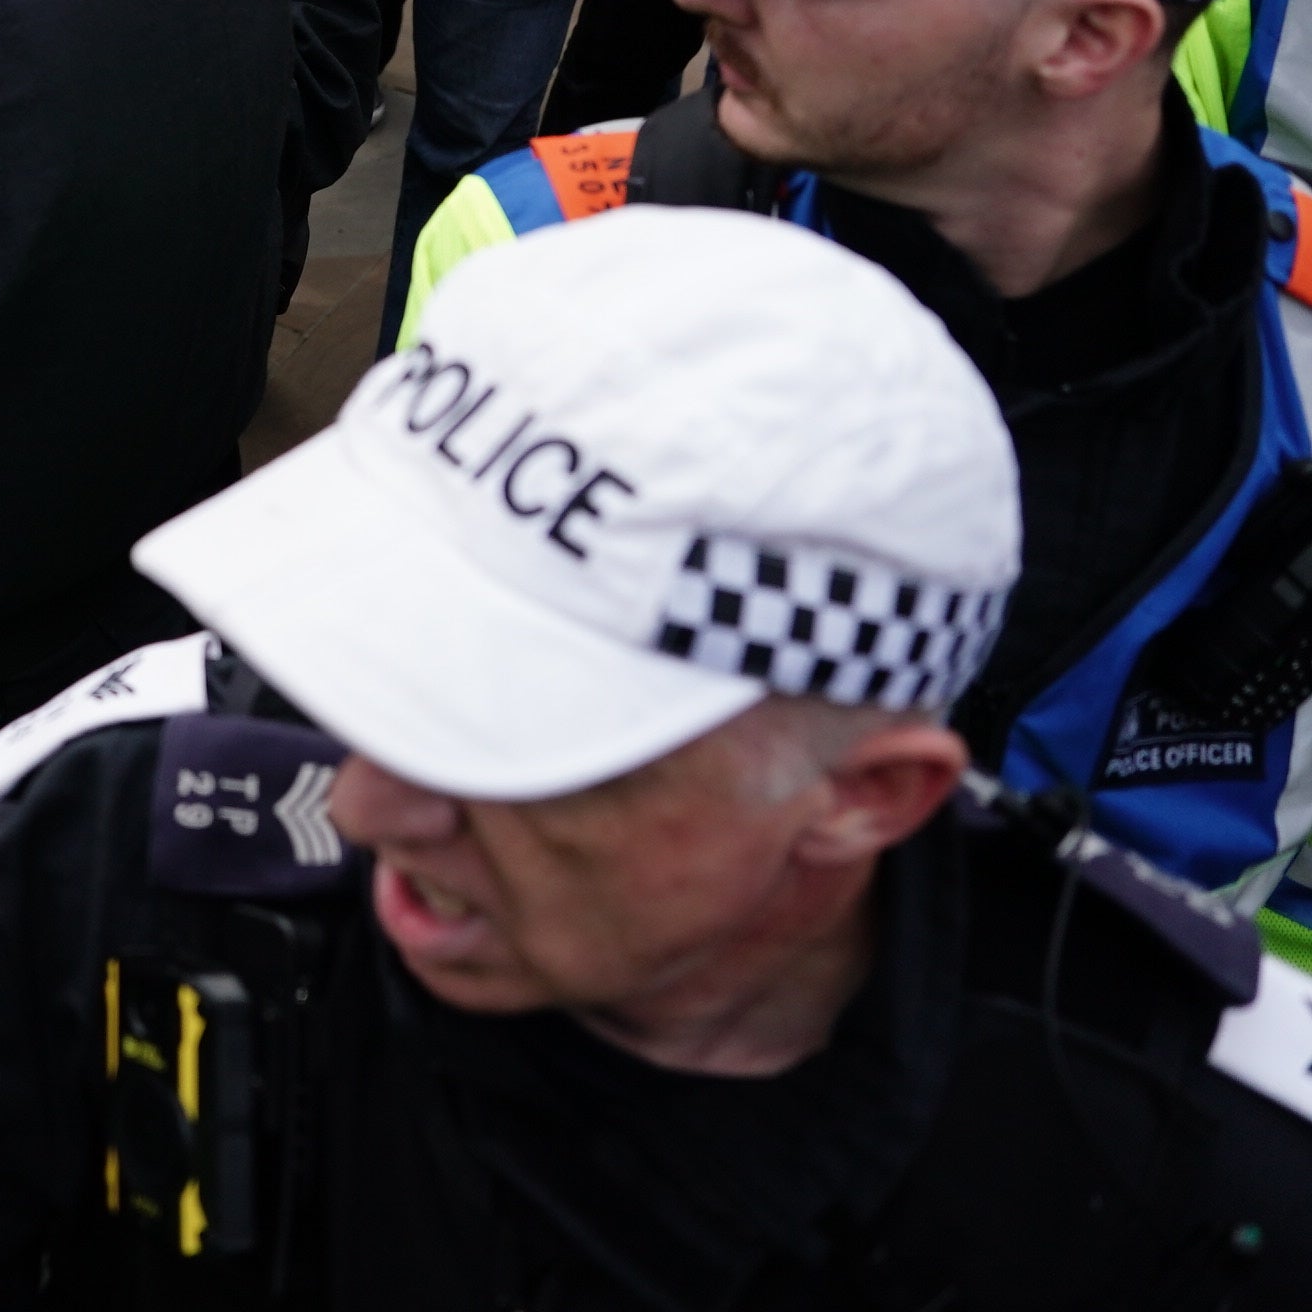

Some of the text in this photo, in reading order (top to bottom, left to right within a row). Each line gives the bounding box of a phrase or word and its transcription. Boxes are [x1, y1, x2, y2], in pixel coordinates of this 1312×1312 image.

[376, 342, 638, 561] POLICE
[1164, 741, 1254, 770] OFFICER
[173, 767, 217, 831] 29
[217, 772, 261, 837] TP
